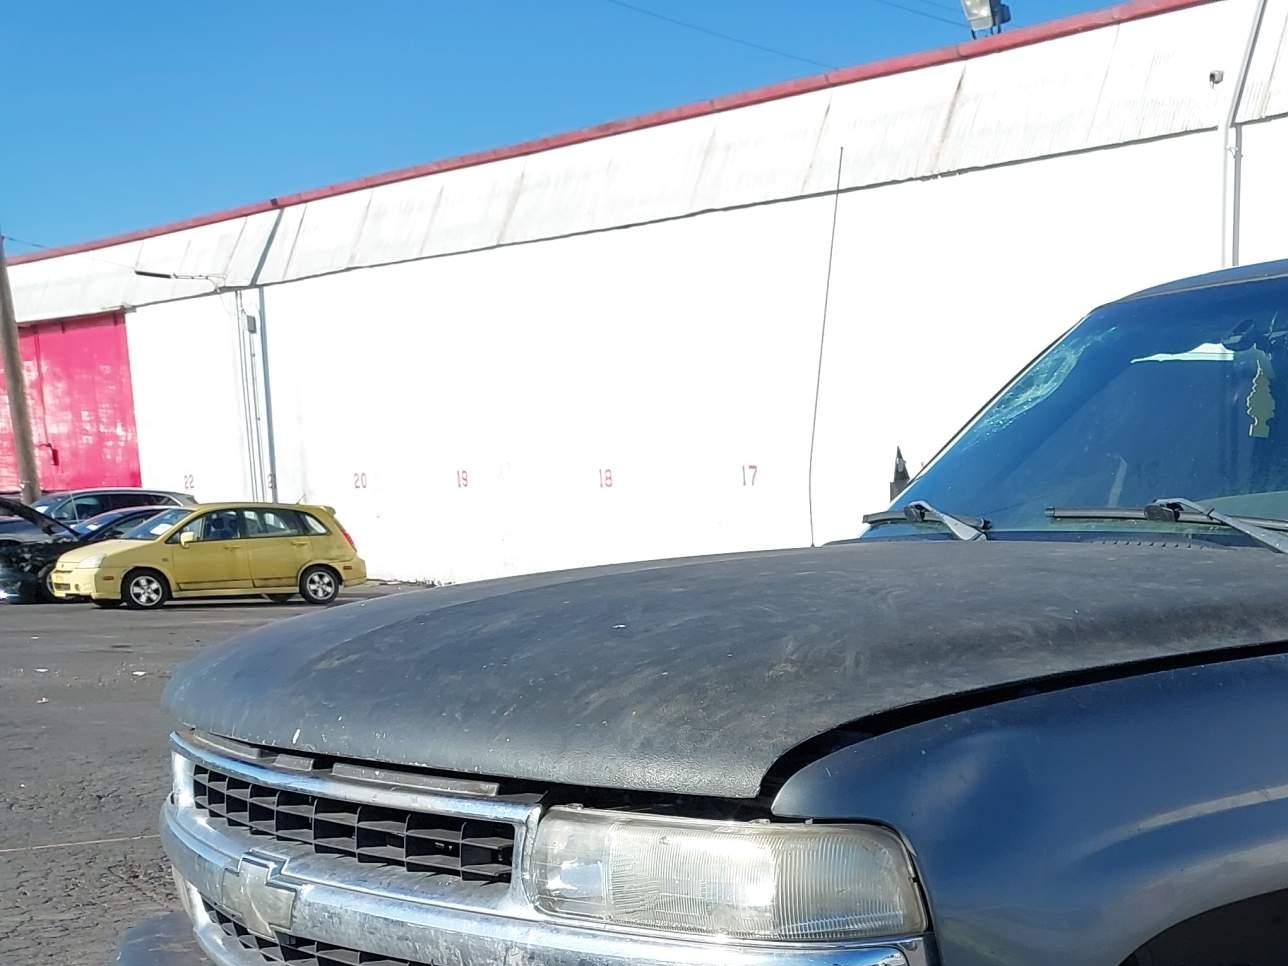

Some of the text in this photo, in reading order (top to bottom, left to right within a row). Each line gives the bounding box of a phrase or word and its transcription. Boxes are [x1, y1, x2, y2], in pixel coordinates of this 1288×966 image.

[183, 474, 195, 489] 22
[353, 472, 368, 489] 20
[456, 470, 469, 488] 19
[599, 468, 613, 488] 18
[742, 465, 758, 487] 17
